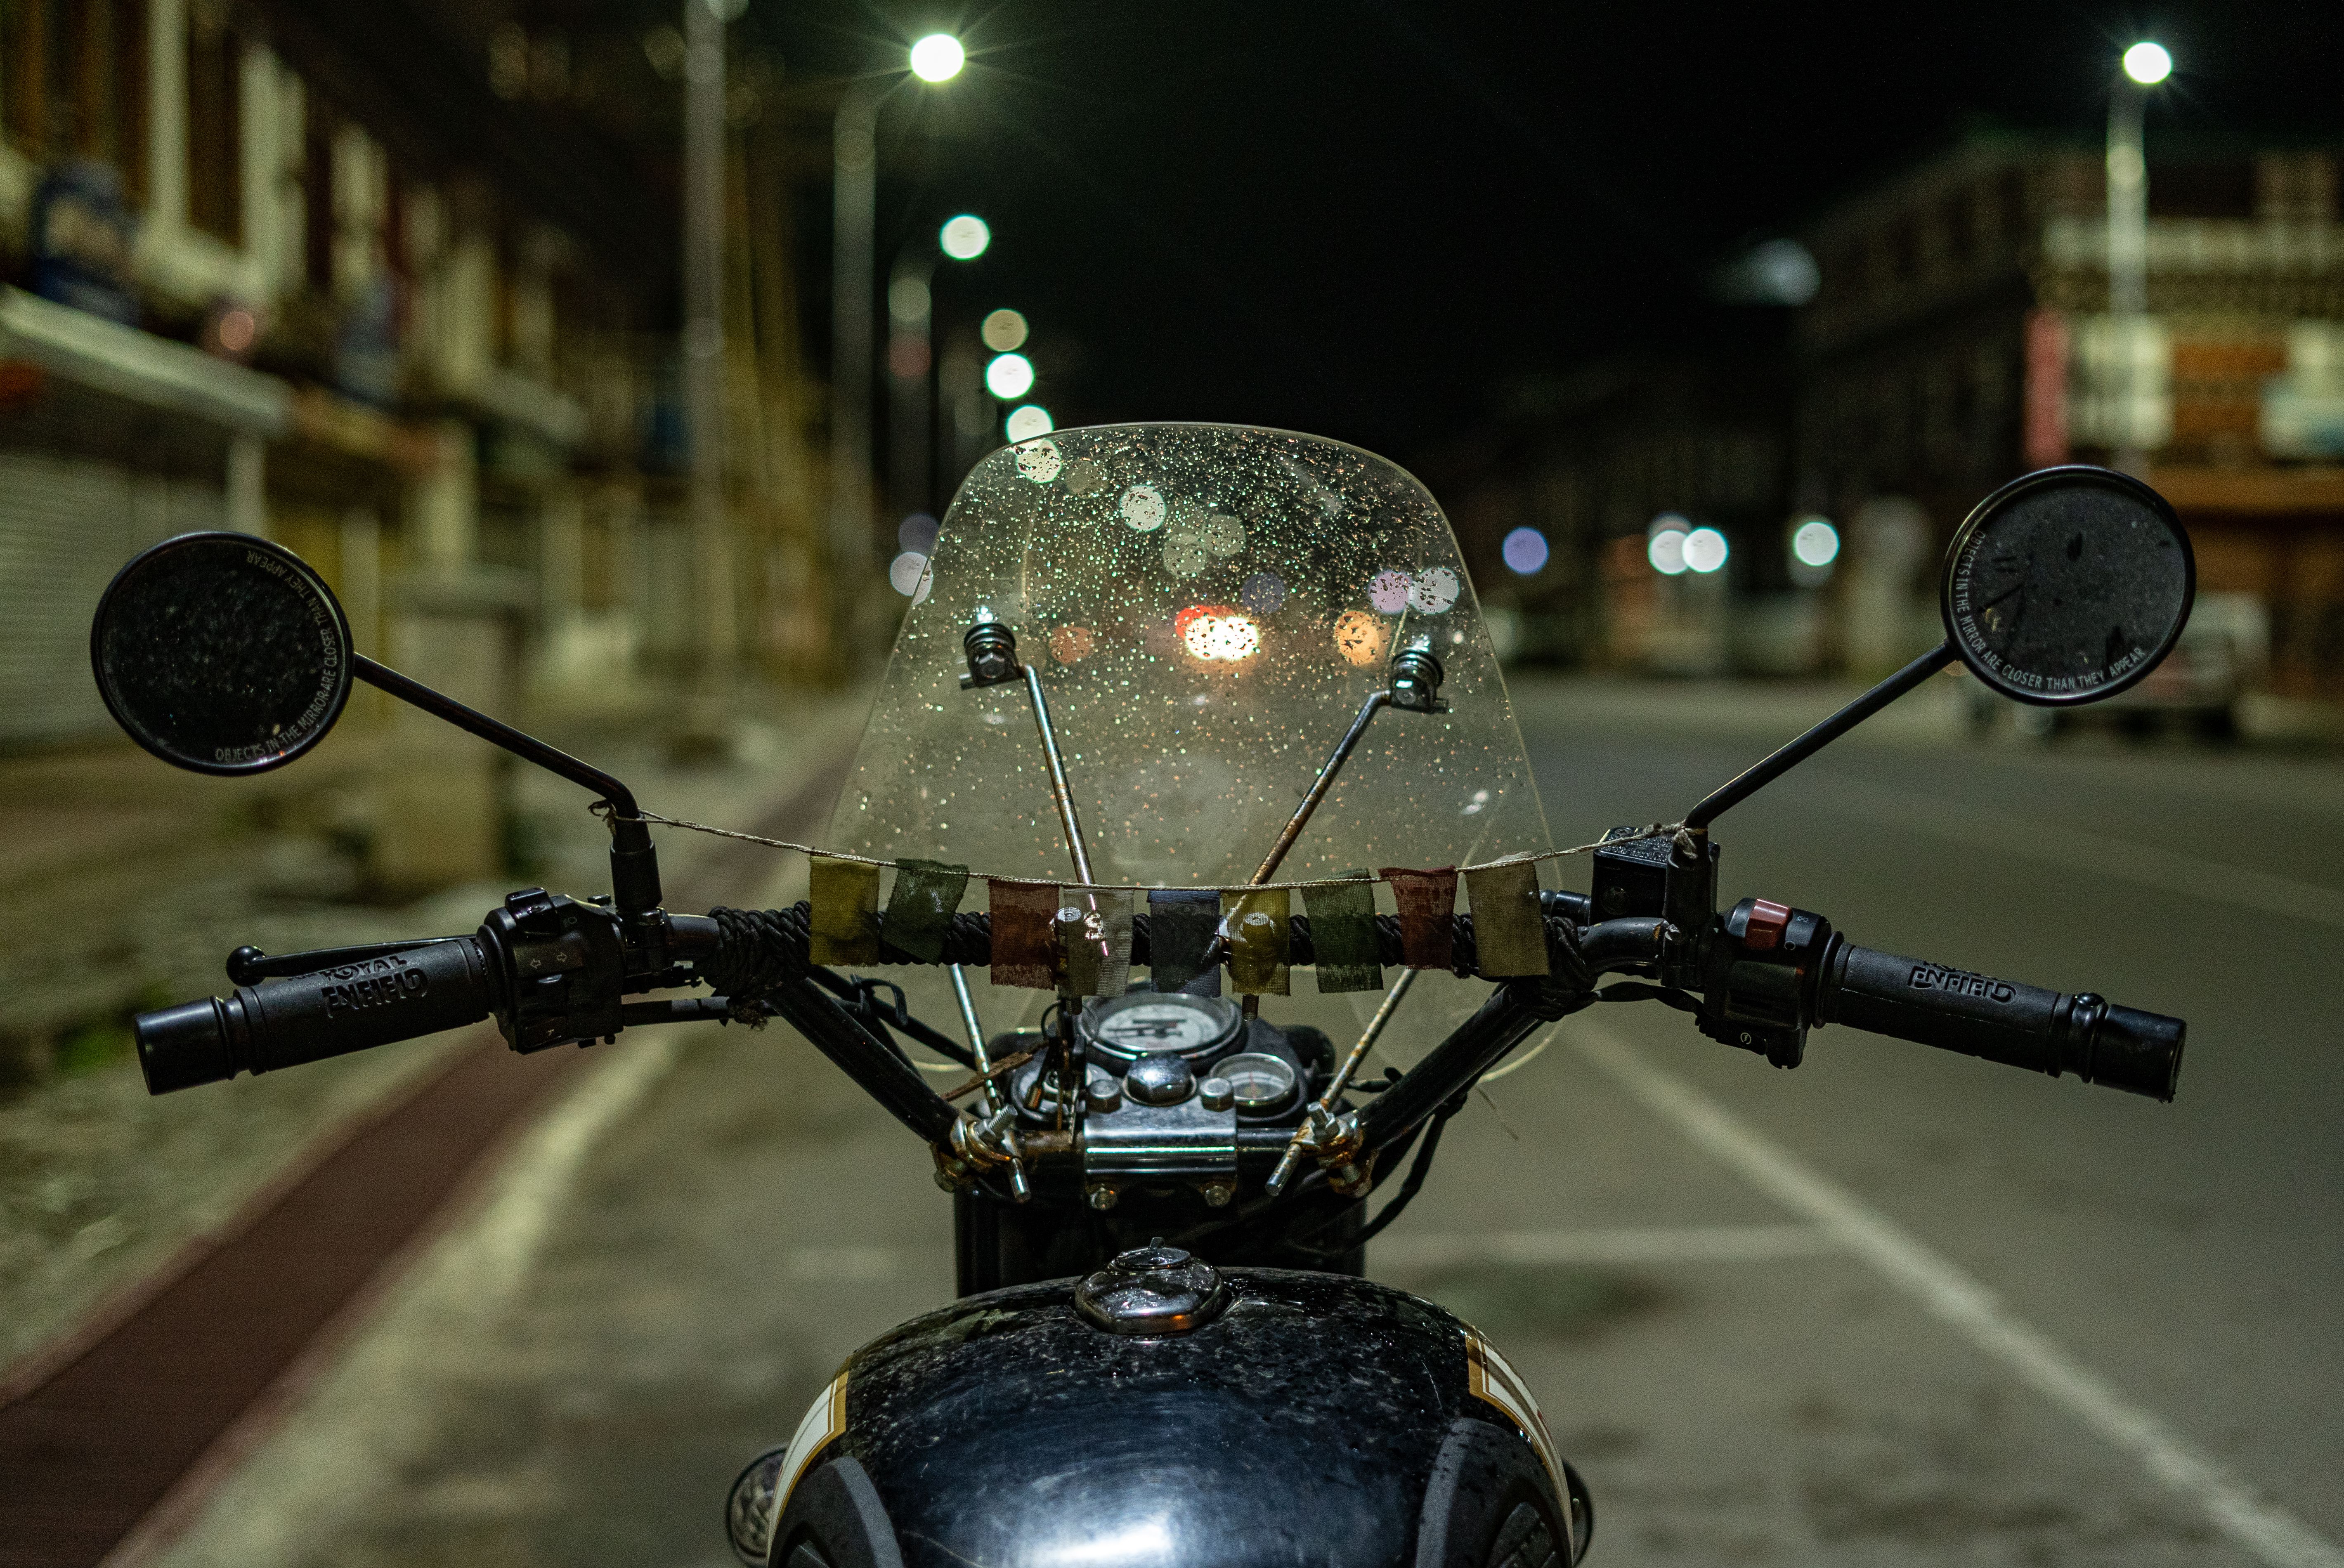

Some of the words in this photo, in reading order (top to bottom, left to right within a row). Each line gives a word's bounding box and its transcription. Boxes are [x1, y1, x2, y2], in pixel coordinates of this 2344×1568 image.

[246, 551, 288, 577] APPEAR
[1957, 530, 1986, 576] OBJECTS
[284, 574, 310, 598] THEY
[1955, 578, 1969, 591] IN
[308, 596, 328, 626] THAN
[1955, 592, 1971, 614] THE
[1960, 615, 1986, 654] MIRROR
[320, 627, 337, 667] CLOSER
[1981, 649, 2003, 671] ARE
[2108, 646, 2146, 678] APPEAR
[321, 668, 336, 691] ARE
[2002, 664, 2043, 689] CLOSER
[2046, 677, 2075, 690] THAN
[2077, 671, 2105, 688] THEY
[298, 690, 330, 730] MIRROR
[266, 737, 281, 752] IN
[279, 725, 302, 744] THE
[215, 744, 266, 760] OBJECTS
[321, 968, 428, 1018] ENFIELD
[1907, 965, 2016, 1004] ENFIELD
